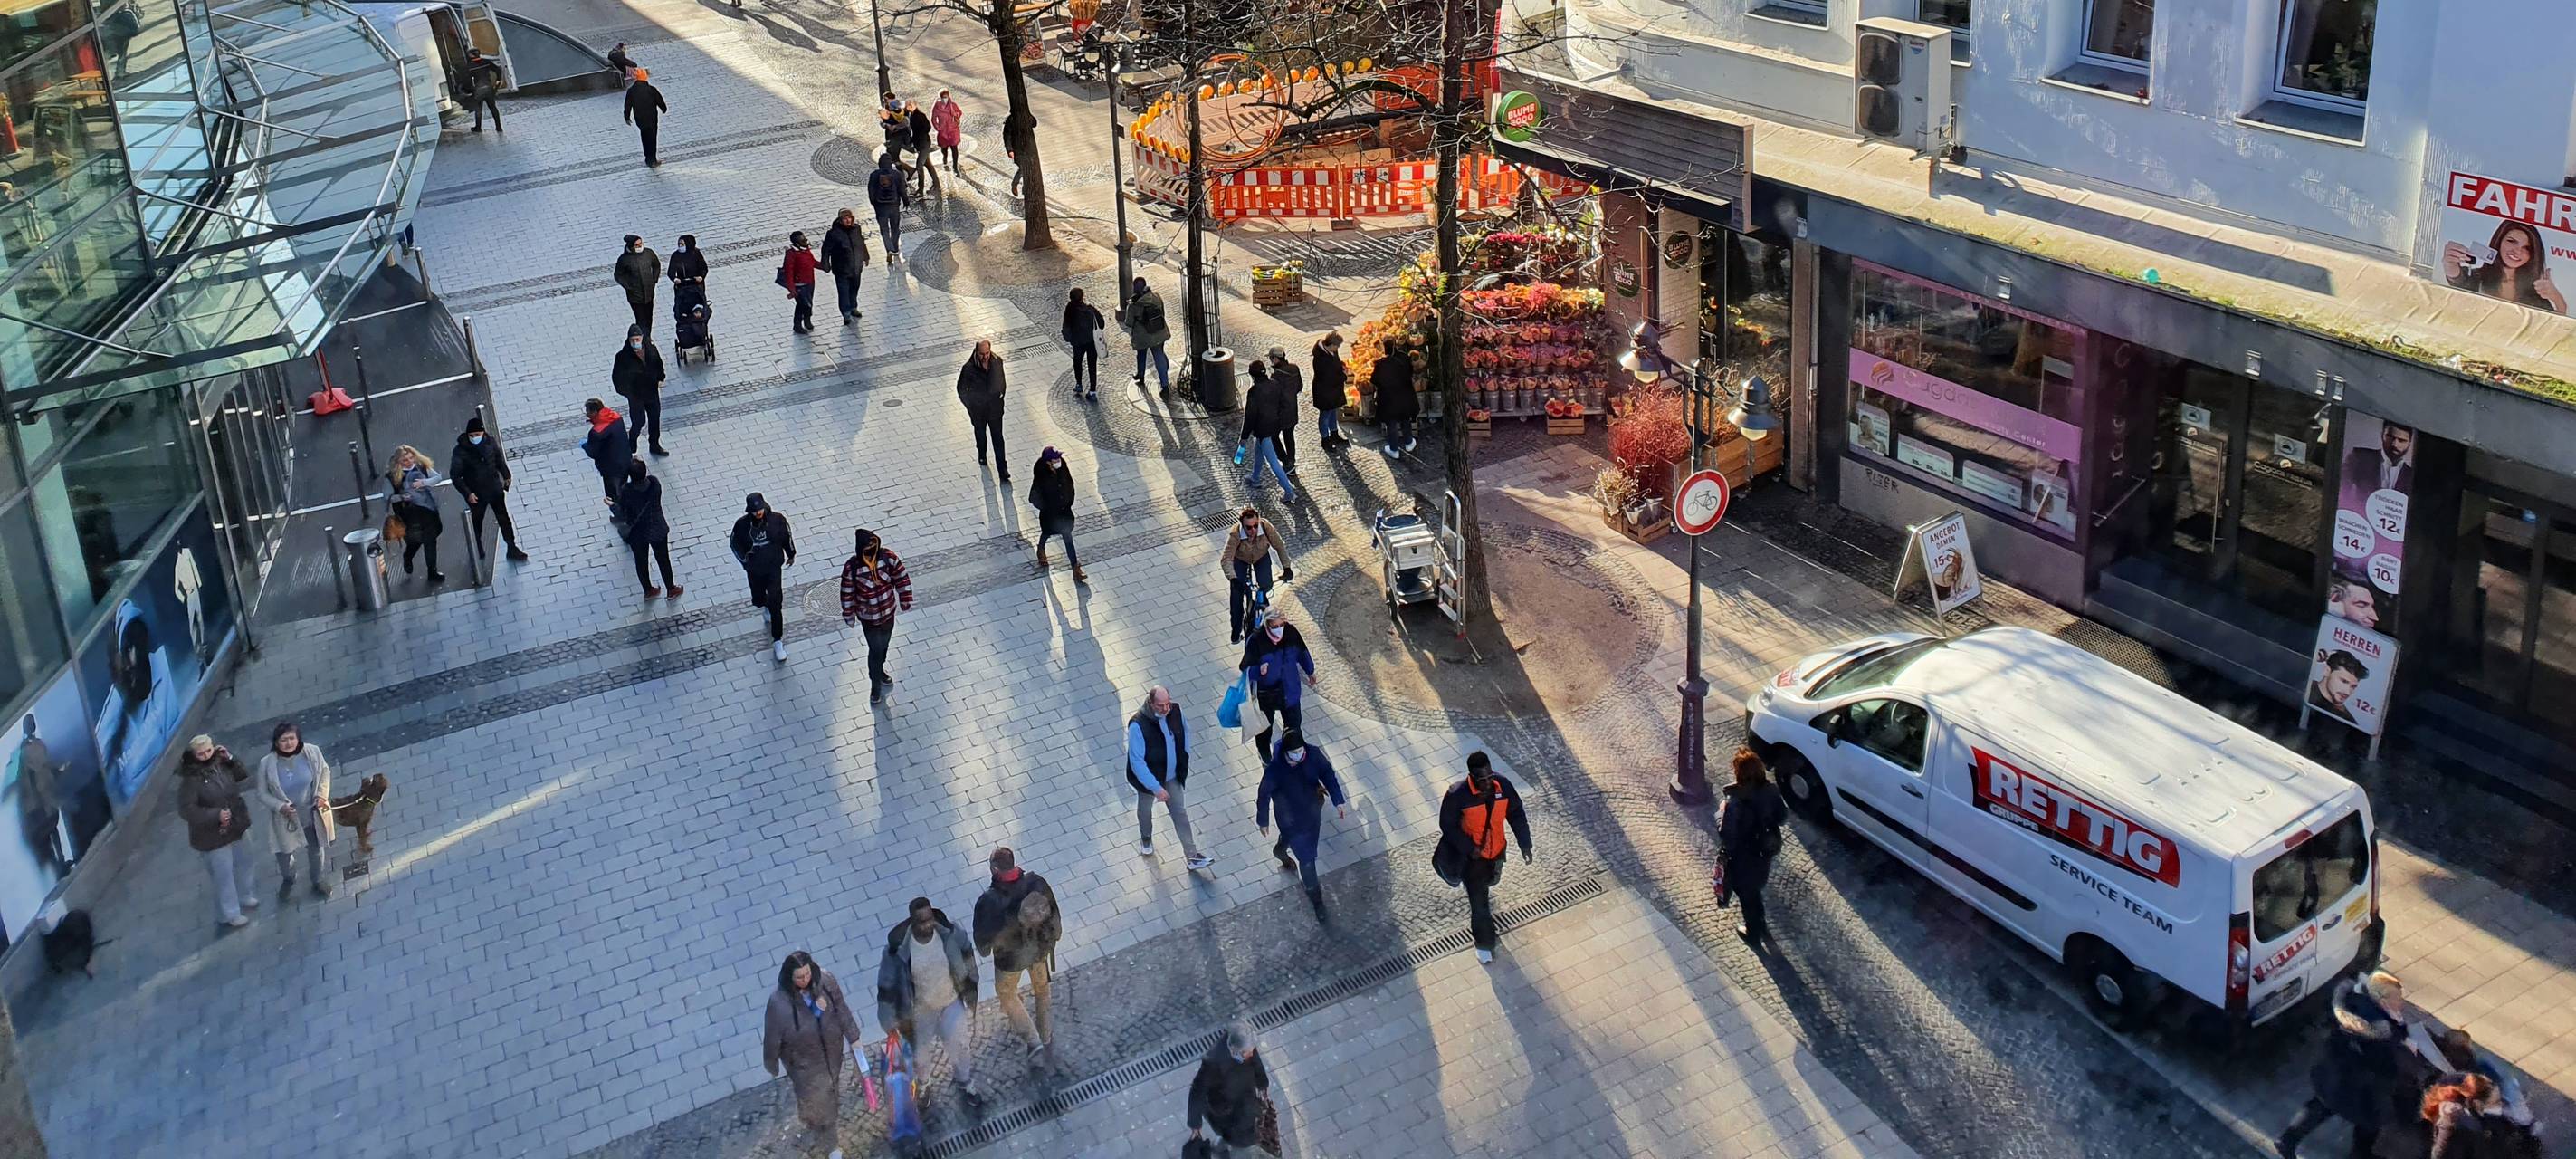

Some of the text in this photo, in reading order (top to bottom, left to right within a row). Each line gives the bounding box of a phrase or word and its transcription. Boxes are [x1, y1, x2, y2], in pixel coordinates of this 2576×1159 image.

[1507, 102, 1535, 120] BLUME
[2450, 174, 2576, 231] FAHR
[1929, 521, 1961, 543] ANGEBOT
[1936, 535, 1956, 550] DAMEN
[2333, 627, 2381, 656] HERREN
[1989, 758, 2163, 874] RETTIG
[1989, 803, 2039, 832] GRUPPE
[2049, 853, 2173, 934] SERVICE TEAM
[2259, 929, 2314, 974] RETTIG
